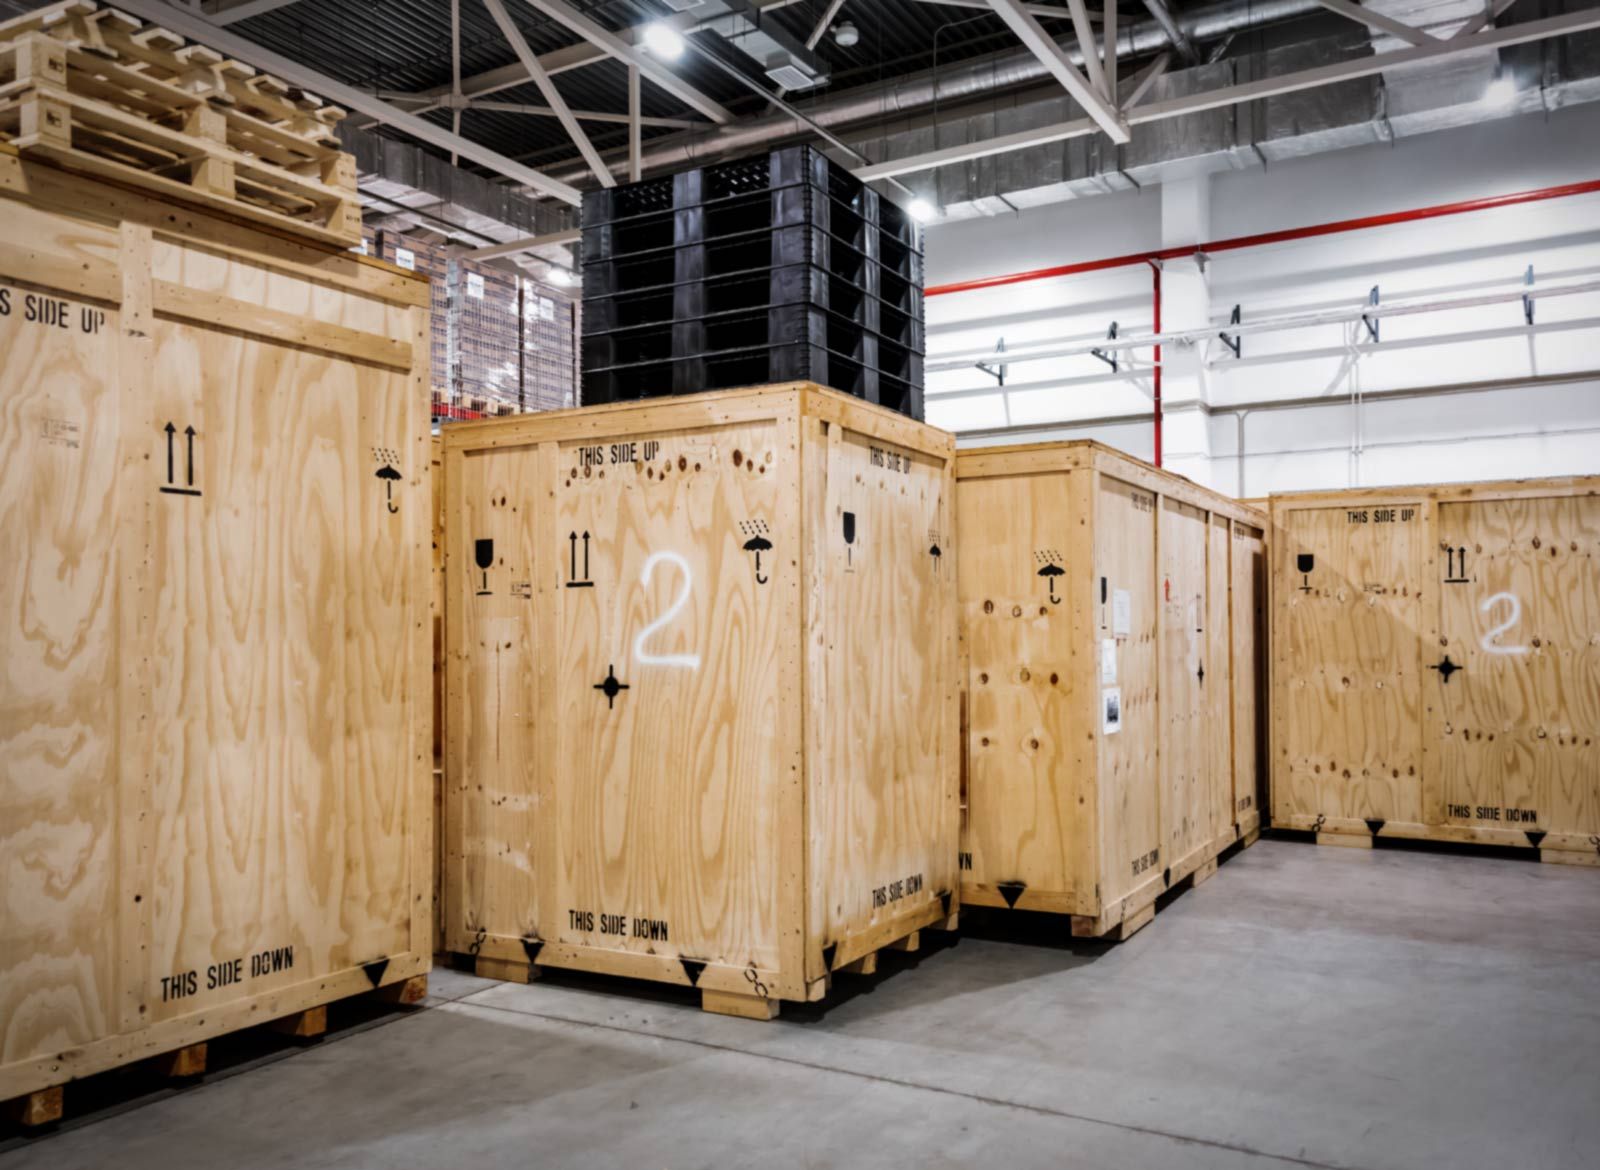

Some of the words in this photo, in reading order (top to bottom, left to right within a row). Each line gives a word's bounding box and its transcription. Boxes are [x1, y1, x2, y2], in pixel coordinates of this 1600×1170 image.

[25, 294, 69, 329] SIDE
[81, 307, 105, 334] UP
[579, 445, 603, 467] THIS
[611, 442, 638, 464] SIDE
[644, 441, 659, 461] UP
[1347, 510, 1368, 523] THIS
[1374, 509, 1396, 523] SIDE
[1401, 508, 1415, 522] UP
[634, 549, 700, 670] 2
[1480, 591, 1529, 655] 2
[1448, 804, 1471, 819] THIS
[1476, 806, 1500, 821] SIDE
[1506, 808, 1537, 824] DOWN
[872, 886, 886, 909] THIS
[889, 880, 903, 902] SIDE
[906, 873, 922, 896] DOWN
[568, 909, 594, 932] THIS
[600, 913, 627, 936] SIDE
[633, 917, 668, 942] DOWN
[160, 970, 197, 1002] THIS
[207, 958, 243, 990] SIDE
[251, 945, 294, 979] DOWN
